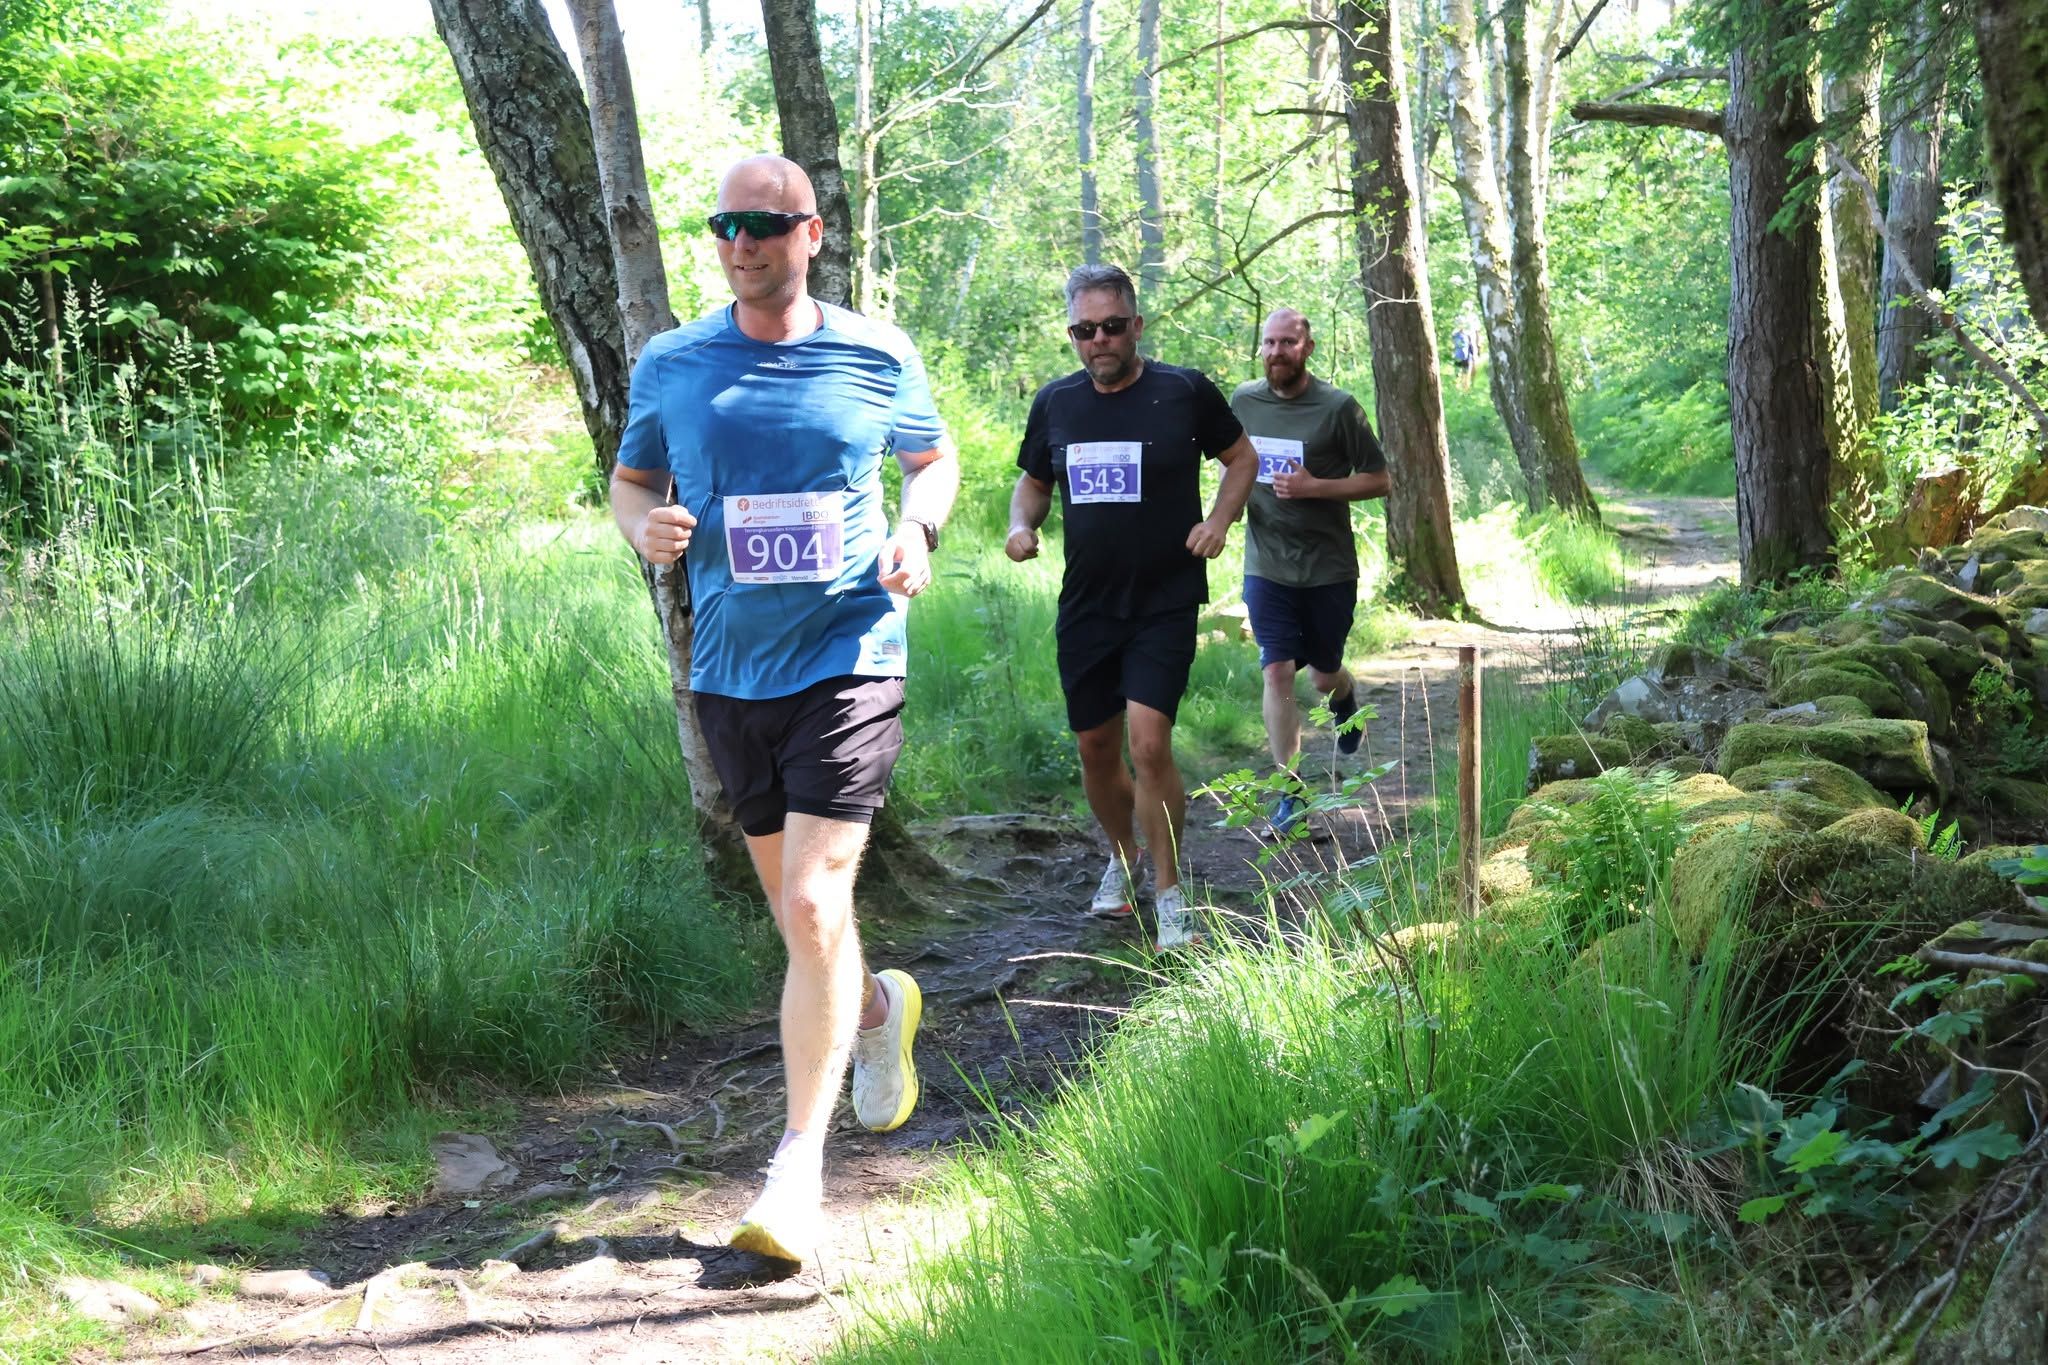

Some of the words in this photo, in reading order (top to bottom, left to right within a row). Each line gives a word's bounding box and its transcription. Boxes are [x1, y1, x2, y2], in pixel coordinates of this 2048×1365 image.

[1079, 467, 1126, 494] 543
[806, 511, 829, 519] BDO
[747, 532, 827, 571] 904
